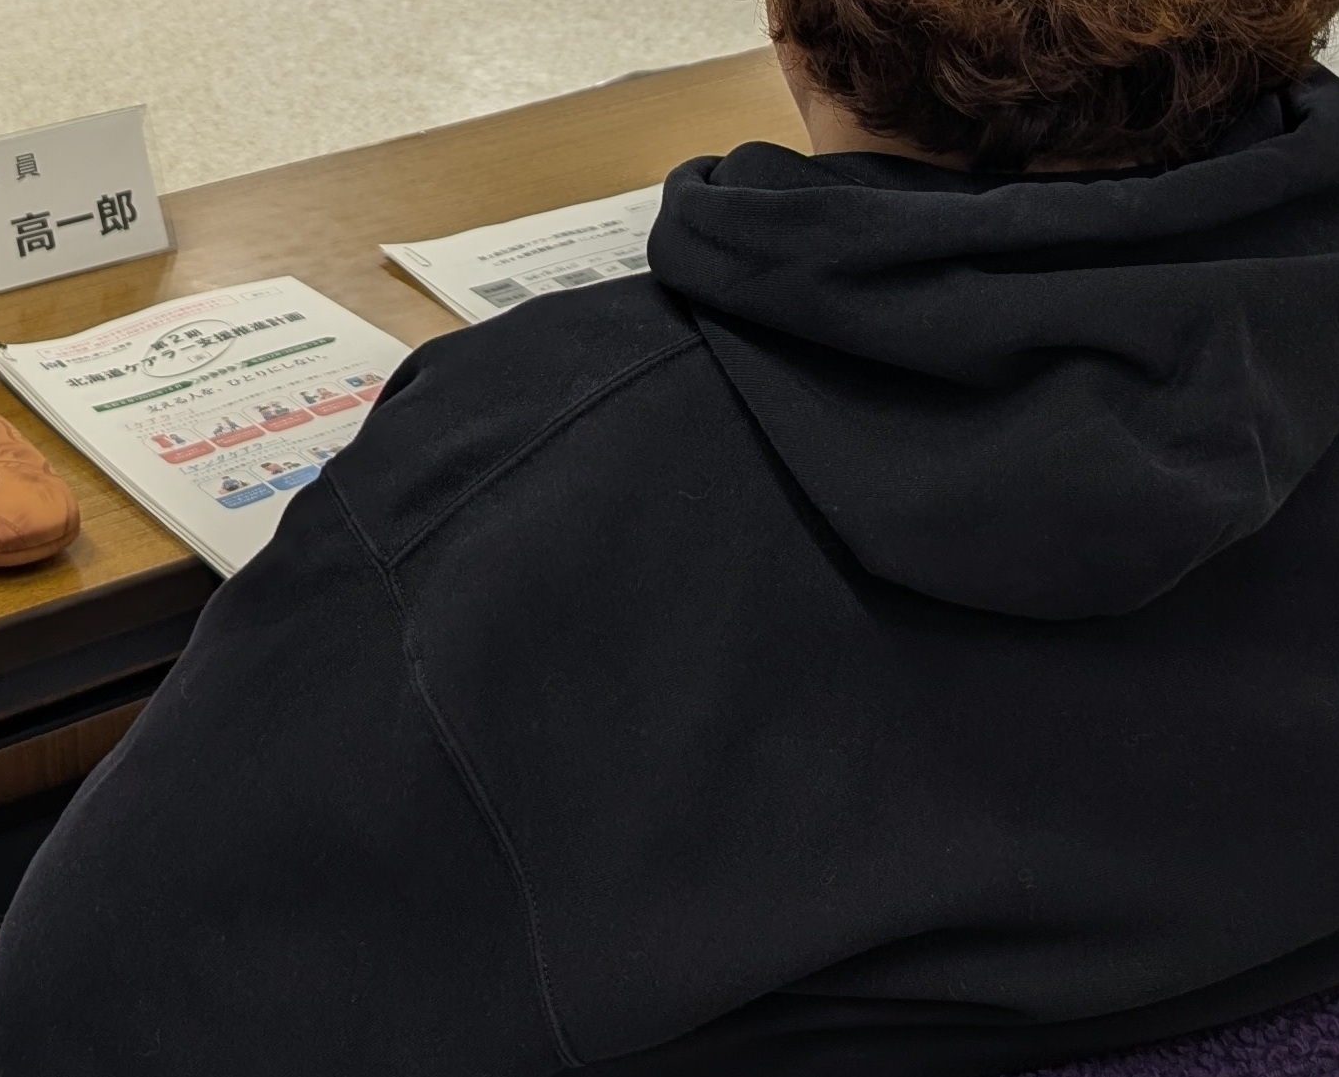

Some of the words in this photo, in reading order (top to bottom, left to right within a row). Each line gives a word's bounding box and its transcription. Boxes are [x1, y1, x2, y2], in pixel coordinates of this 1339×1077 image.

[10, 189, 138, 257] 高一郎
[65, 311, 306, 388] 北海道ケアラー支援推進計画
